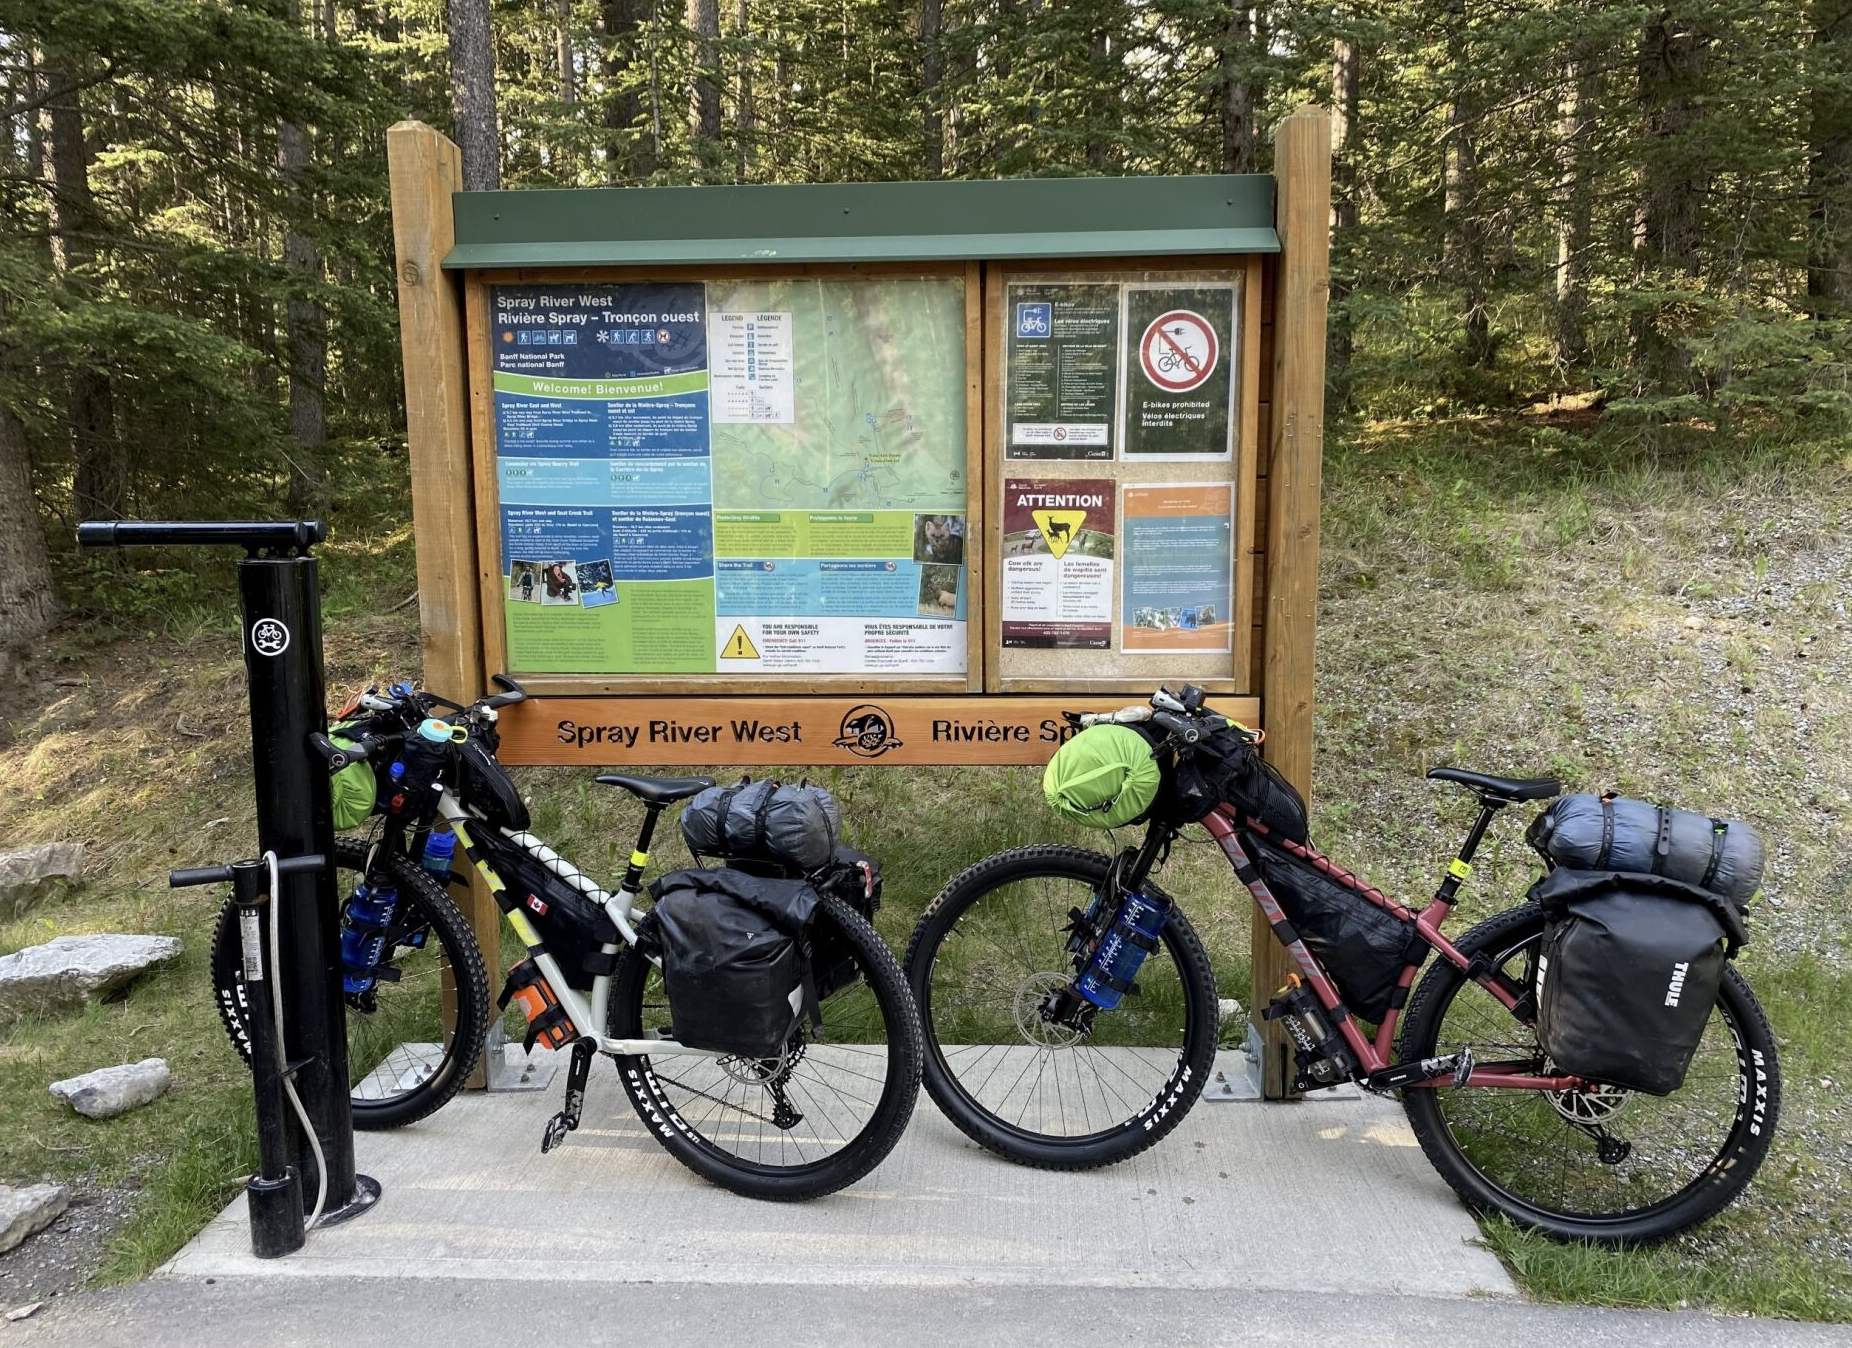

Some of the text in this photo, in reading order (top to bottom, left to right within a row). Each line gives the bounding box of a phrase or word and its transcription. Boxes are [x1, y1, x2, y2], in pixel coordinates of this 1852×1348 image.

[497, 295, 613, 309] Spray River West
[498, 312, 545, 324] Rivière
[549, 312, 587, 325] Spray
[602, 311, 657, 326] Tronçon
[661, 311, 700, 323] ouest
[532, 381, 663, 394] Welcome! Bienvenue!
[1016, 494, 1103, 507] ATTENTION
[557, 720, 802, 748] Spray River West
[931, 719, 1030, 743] Rivière
[1664, 961, 1690, 1008] THULE
[627, 1069, 675, 1138] MAXXIS
[1143, 1064, 1193, 1131] MAXXIS
[1750, 1048, 1768, 1137] MAXXIS
